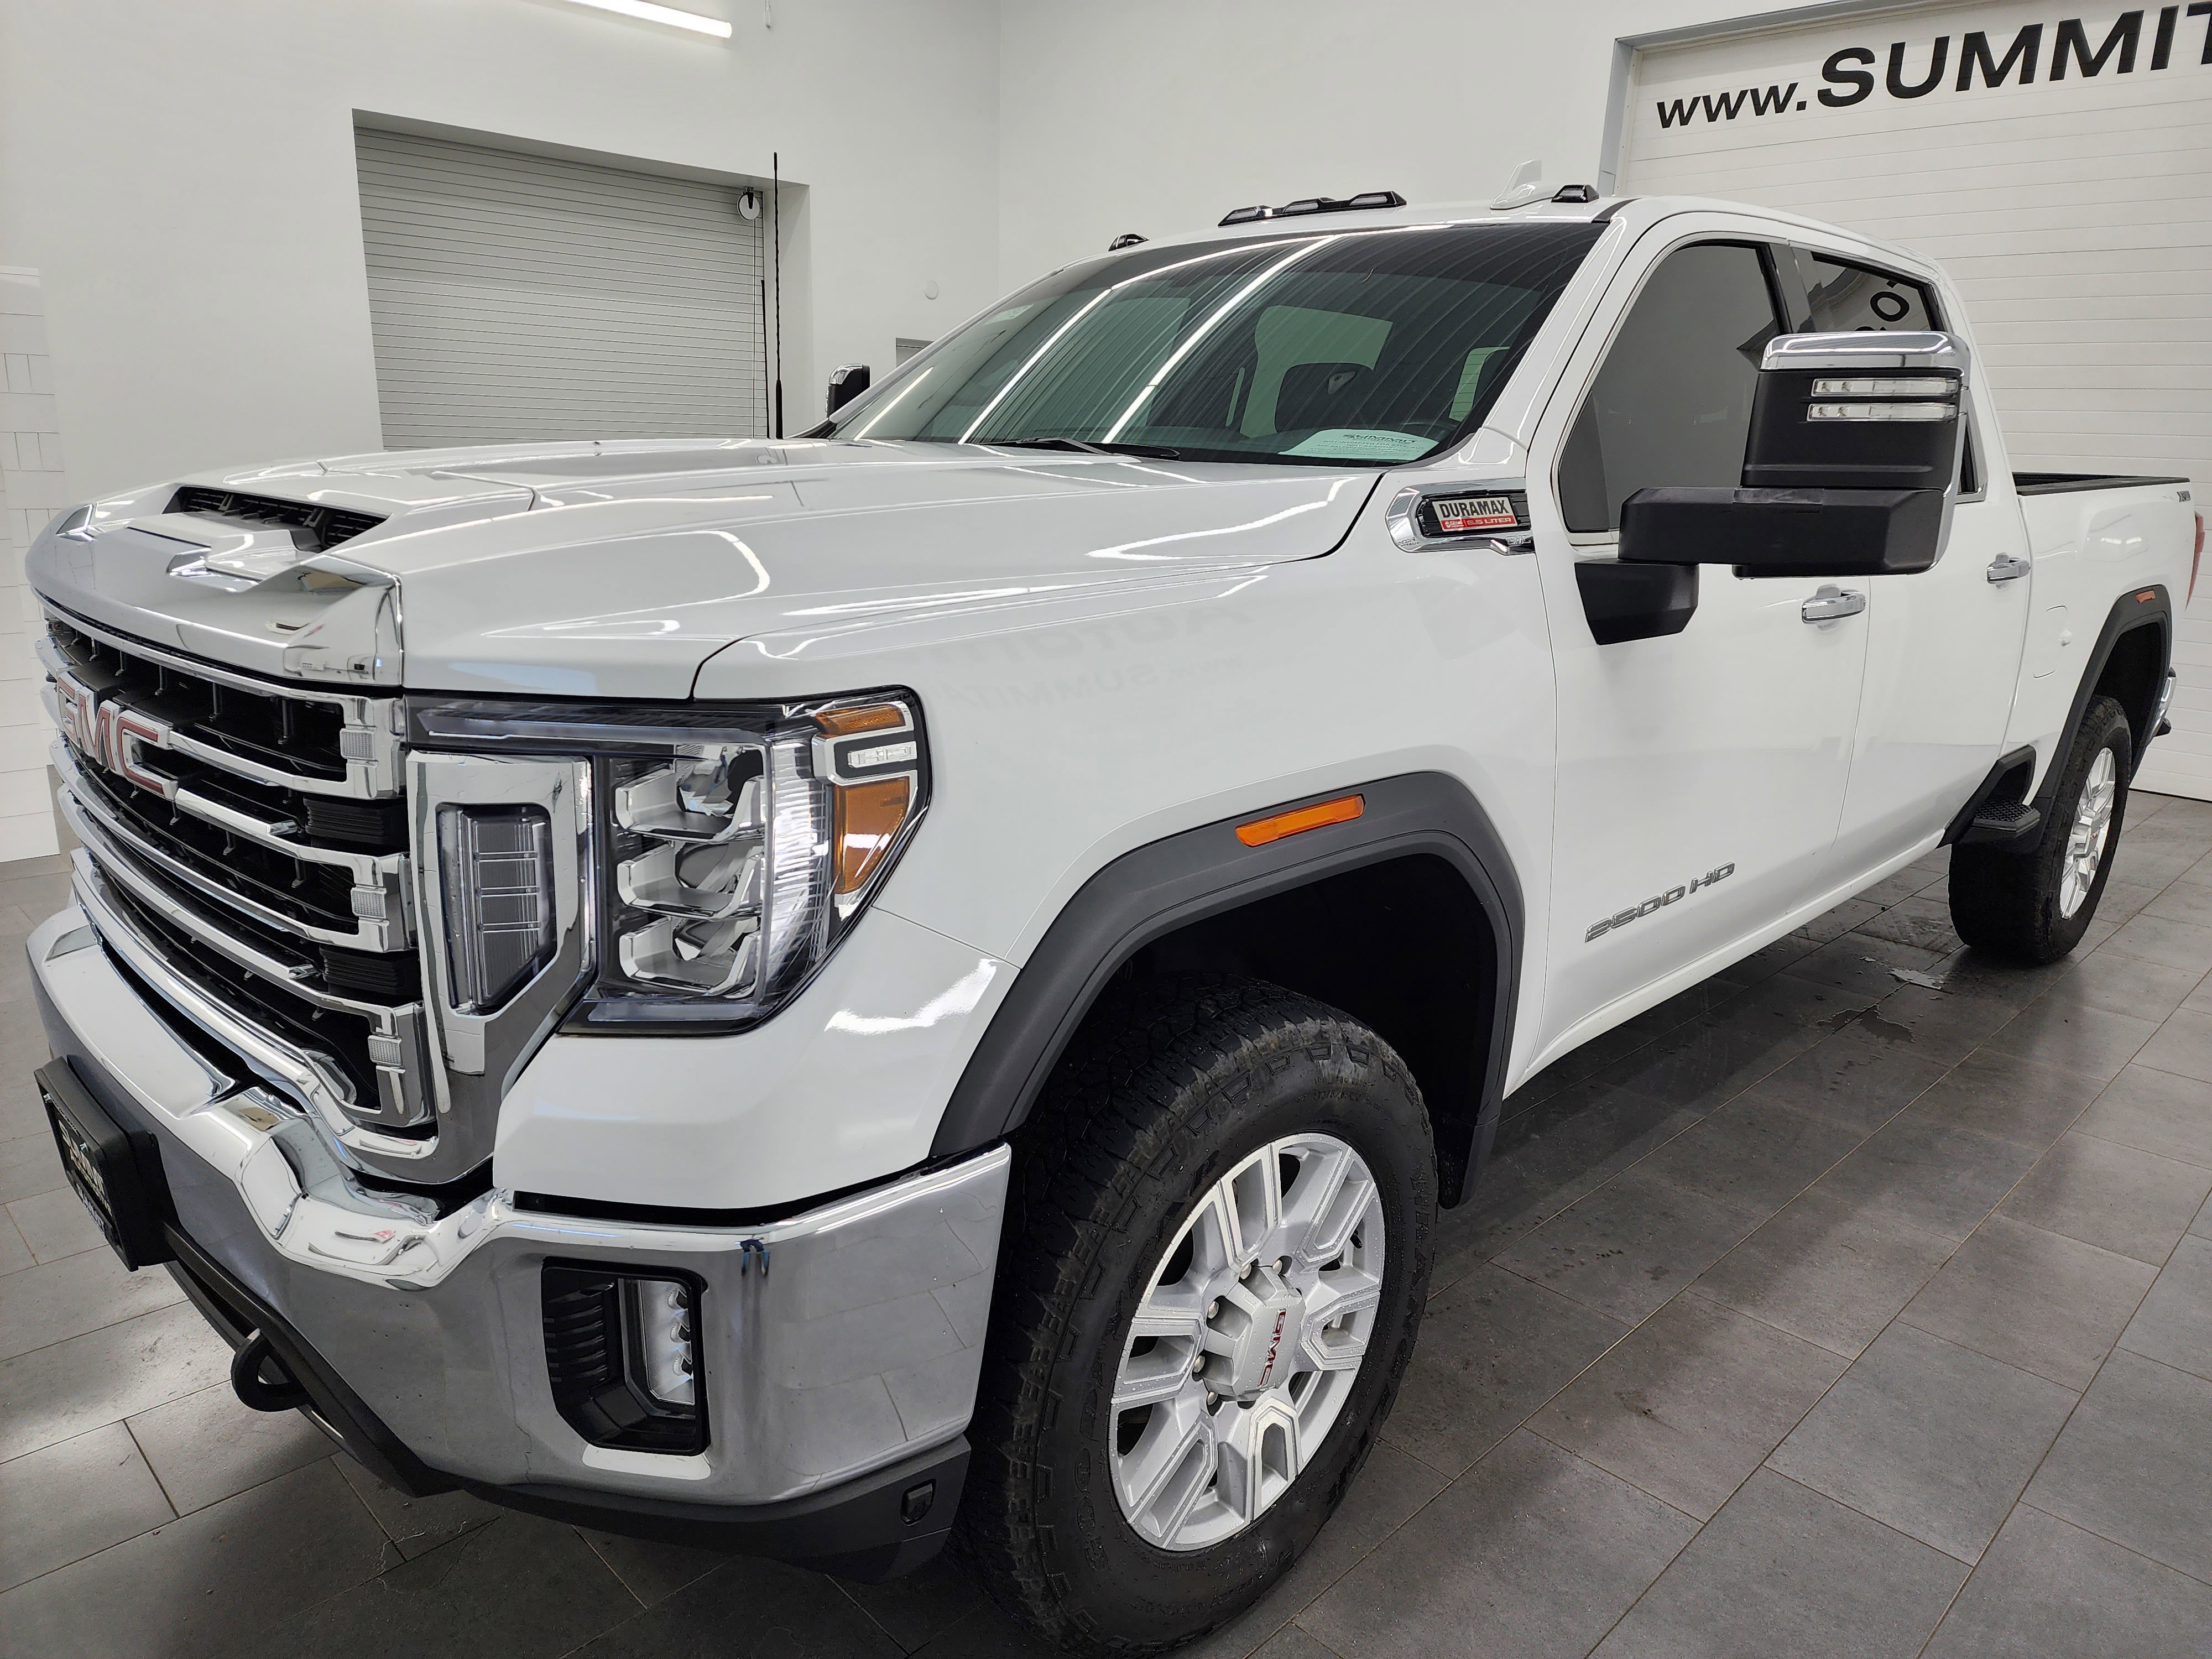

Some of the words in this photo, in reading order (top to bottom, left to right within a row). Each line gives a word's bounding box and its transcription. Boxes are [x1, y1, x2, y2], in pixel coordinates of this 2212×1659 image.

[1439, 499, 1510, 518] DURAMAX
[56, 669, 178, 802] GMC
[1585, 885, 1686, 943] 2500
[1689, 862, 1735, 894] HD
[1256, 1308, 1286, 1387] GMC
